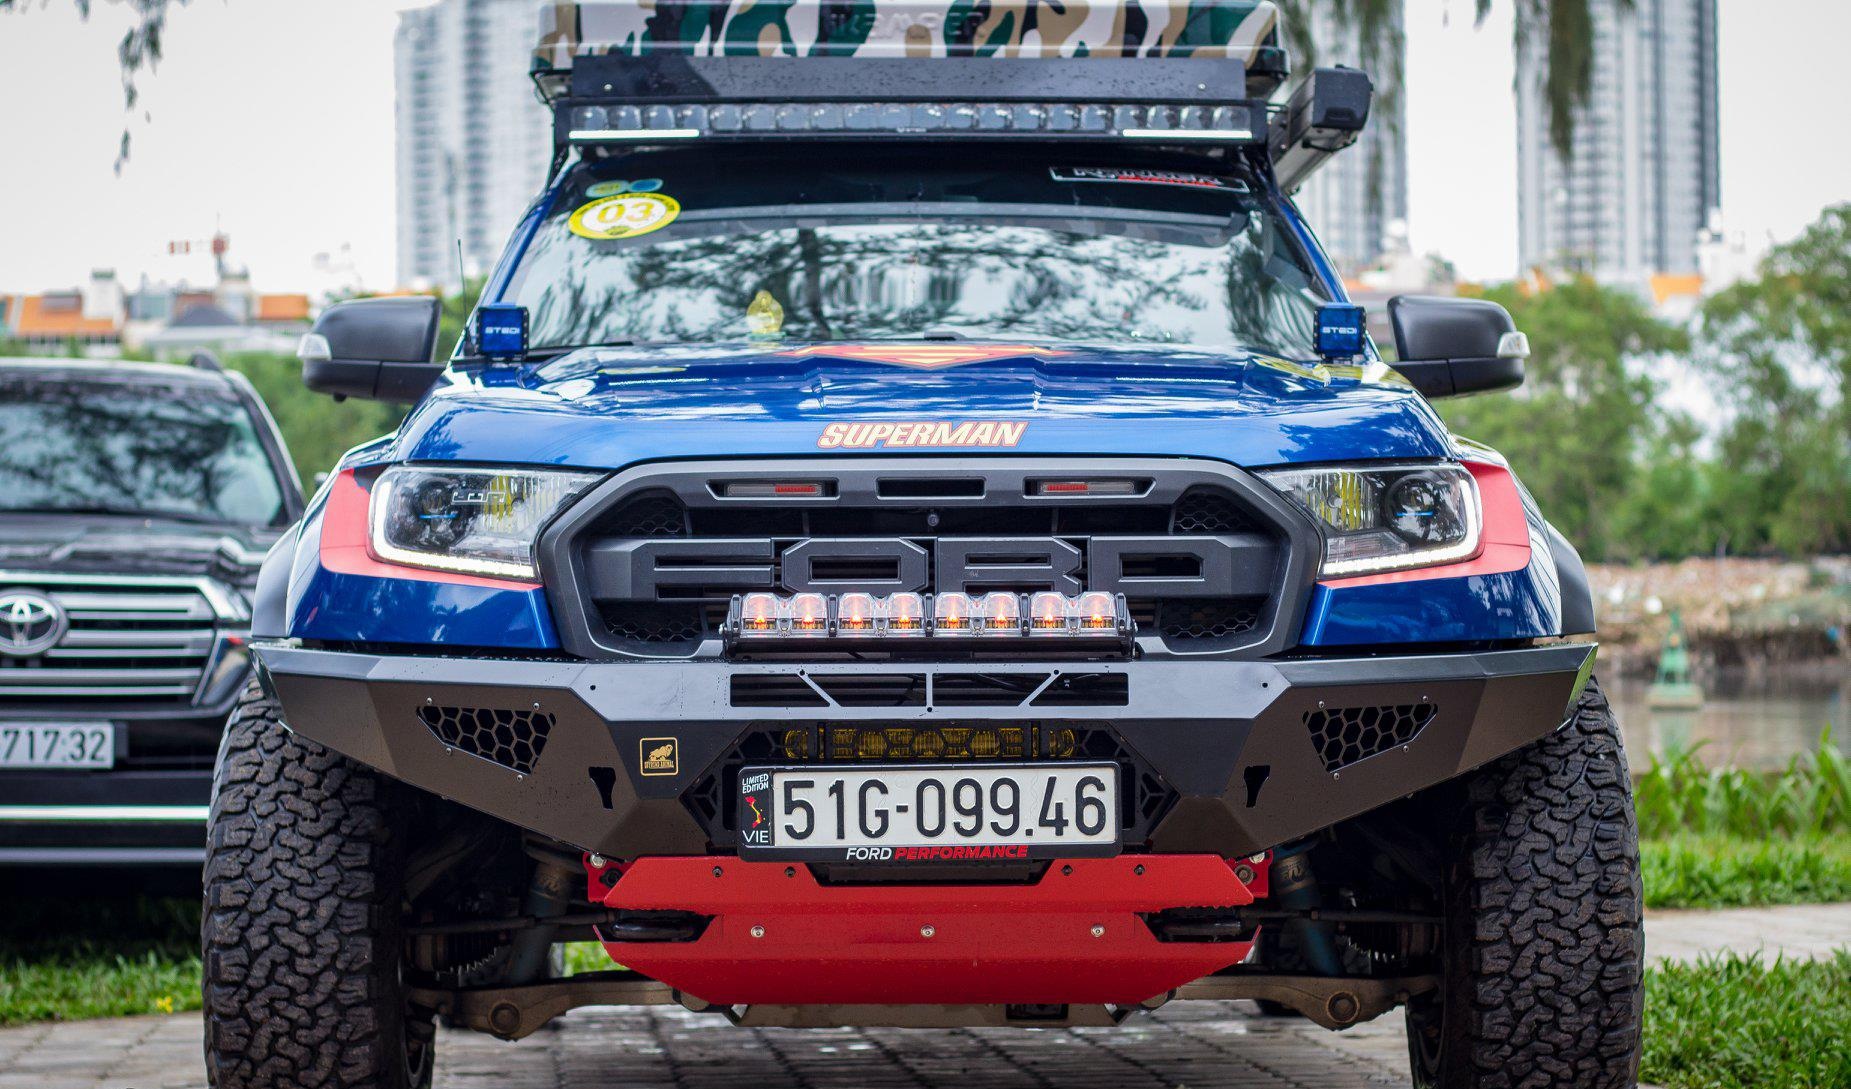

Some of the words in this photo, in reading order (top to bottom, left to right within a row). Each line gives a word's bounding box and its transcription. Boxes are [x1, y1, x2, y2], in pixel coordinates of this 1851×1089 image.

[598, 201, 655, 224] 03
[485, 326, 521, 335] STEDI
[1322, 326, 1358, 335] STEDI
[817, 421, 1029, 449] SUPERMAN
[626, 535, 1224, 599] FORD
[742, 773, 769, 786] LIMITED
[742, 781, 769, 794] EDITION
[783, 775, 1107, 841] 51G-099.46
[742, 830, 769, 843] VIE
[846, 847, 892, 861] FORD
[894, 844, 1029, 860] PERFORMANCE
